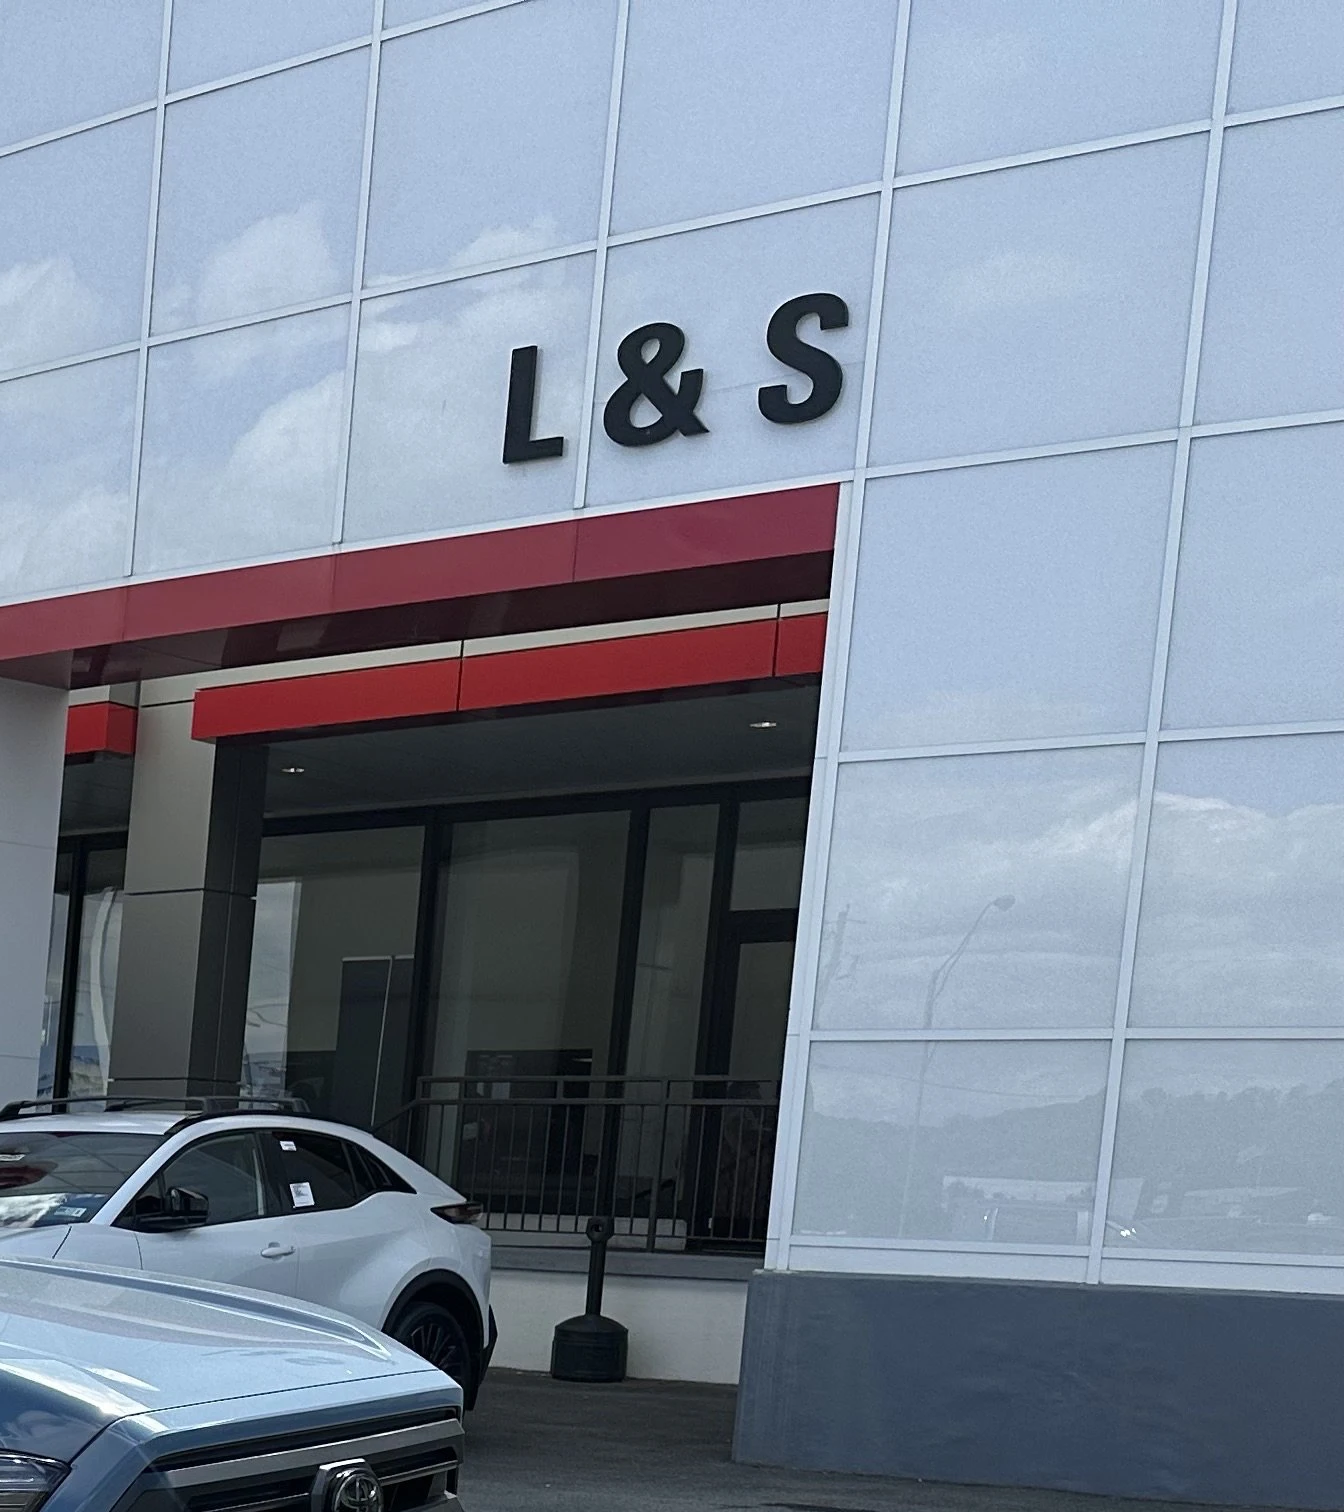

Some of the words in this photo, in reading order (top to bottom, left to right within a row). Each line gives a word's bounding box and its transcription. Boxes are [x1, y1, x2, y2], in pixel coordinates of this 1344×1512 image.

[503, 345, 564, 464] L
[603, 322, 710, 447] &
[758, 292, 849, 424] S
